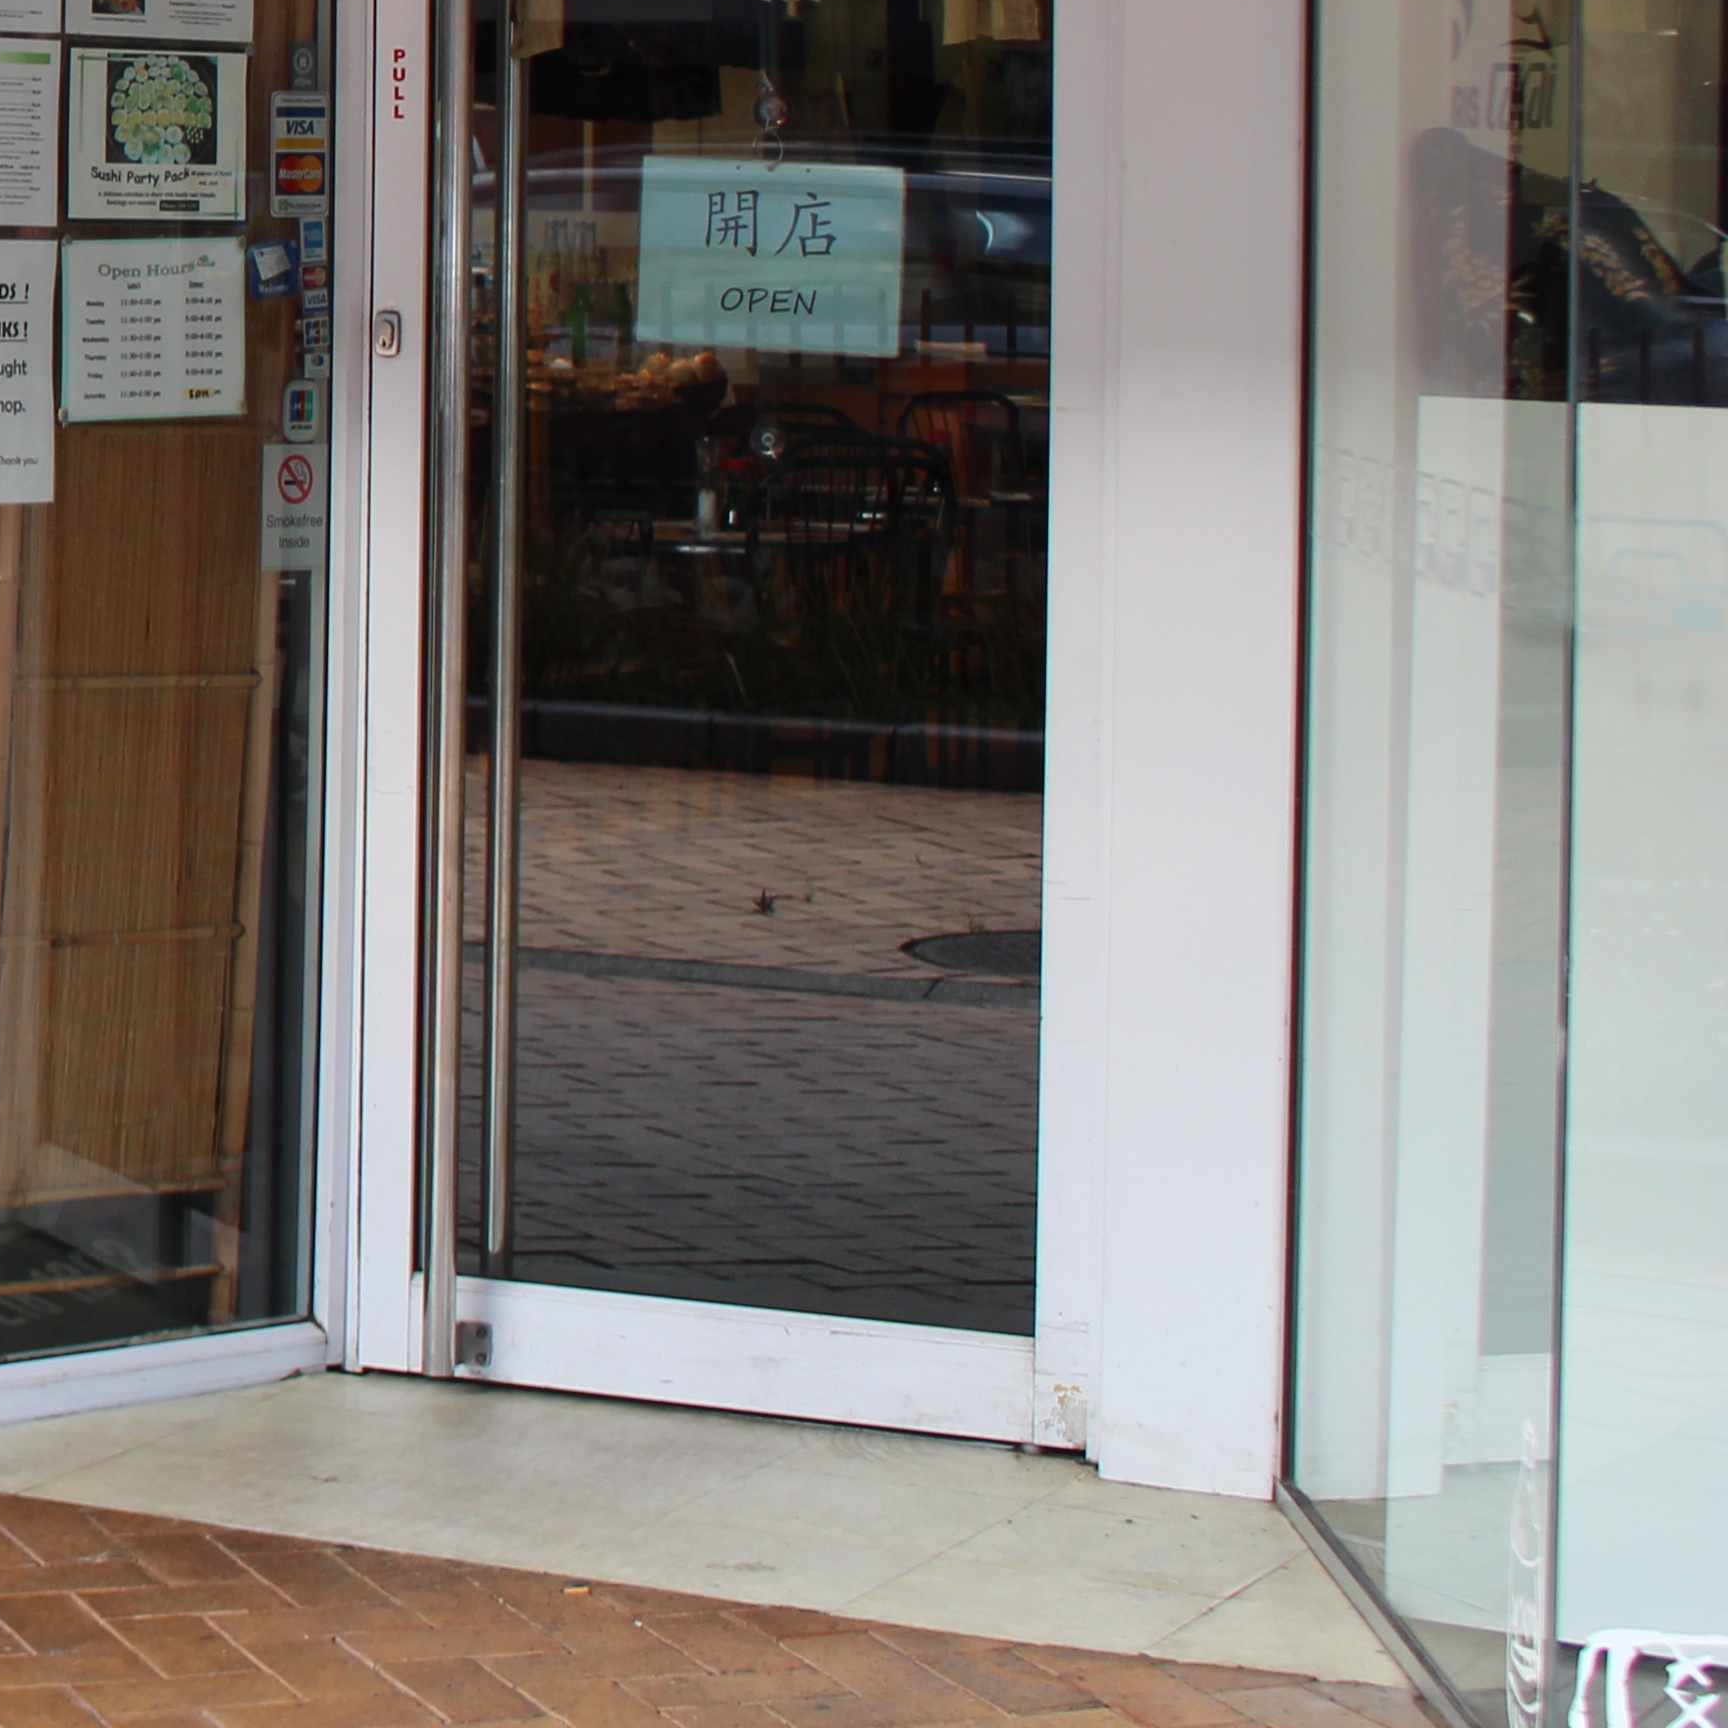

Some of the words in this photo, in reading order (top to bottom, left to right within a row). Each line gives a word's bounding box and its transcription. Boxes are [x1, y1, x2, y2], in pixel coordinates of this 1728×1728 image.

[393, 49, 406, 119] PULL
[286, 120, 314, 135] VISA
[90, 165, 122, 183] Sushi
[127, 170, 160, 188] Party
[164, 167, 191, 183] Pack
[704, 189, 837, 258] 開店
[98, 263, 141, 280] Open
[146, 260, 195, 277] Hours
[720, 285, 818, 315] OPEN
[23, 457, 39, 467] you
[266, 514, 323, 529] Smokefree
[279, 534, 310, 549] Inside
